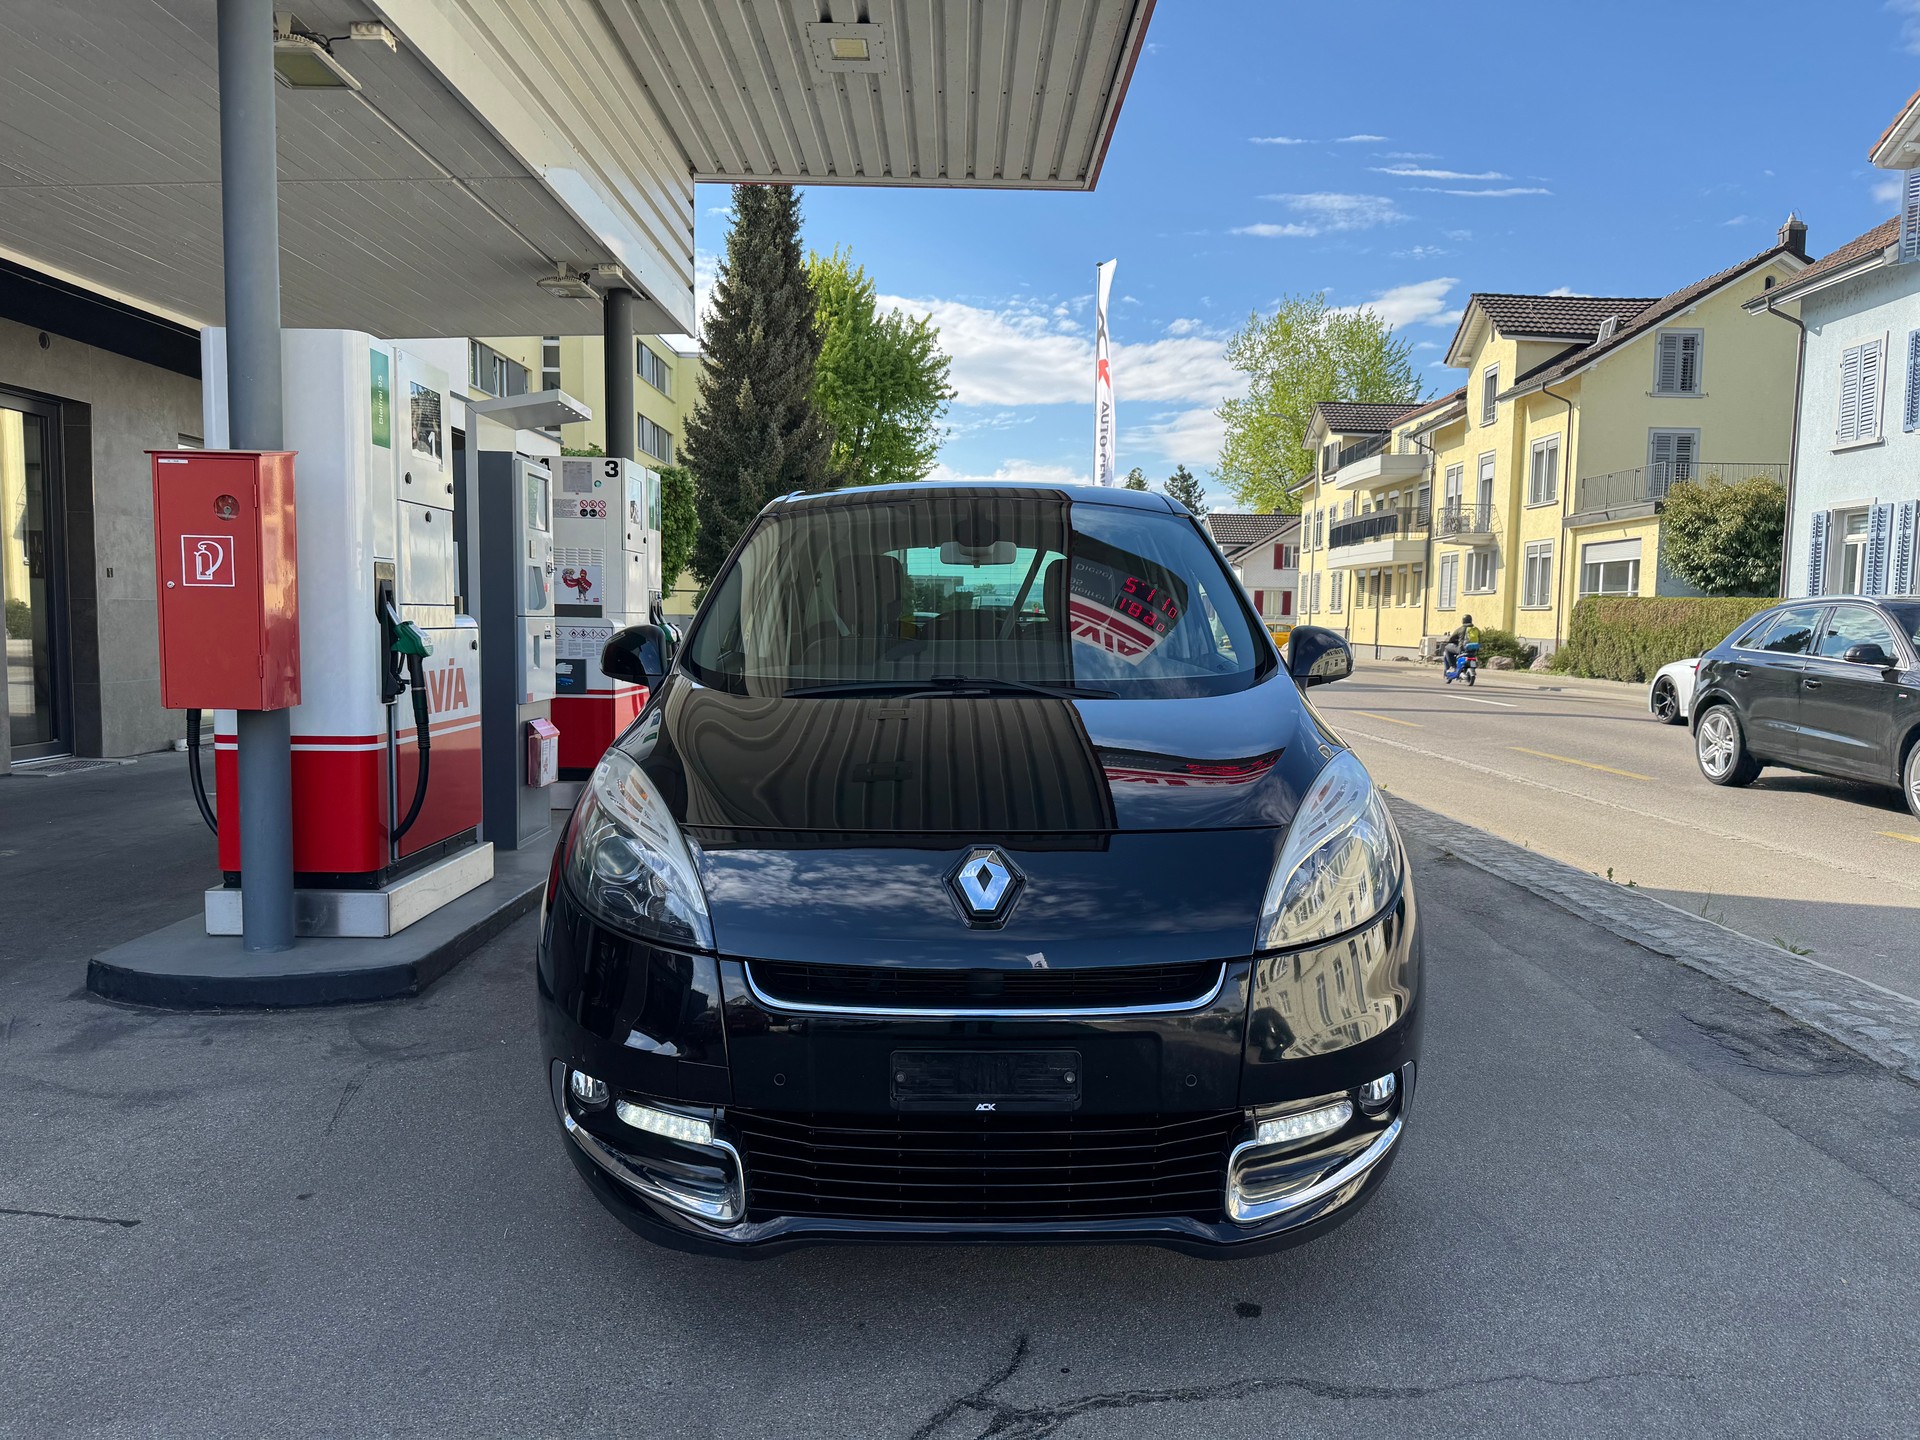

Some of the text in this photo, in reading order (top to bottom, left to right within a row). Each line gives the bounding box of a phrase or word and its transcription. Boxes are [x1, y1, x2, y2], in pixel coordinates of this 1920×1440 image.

[1099, 401, 1110, 447] AUTO
[604, 460, 619, 478] 3
[975, 1103, 996, 1111] ACK
